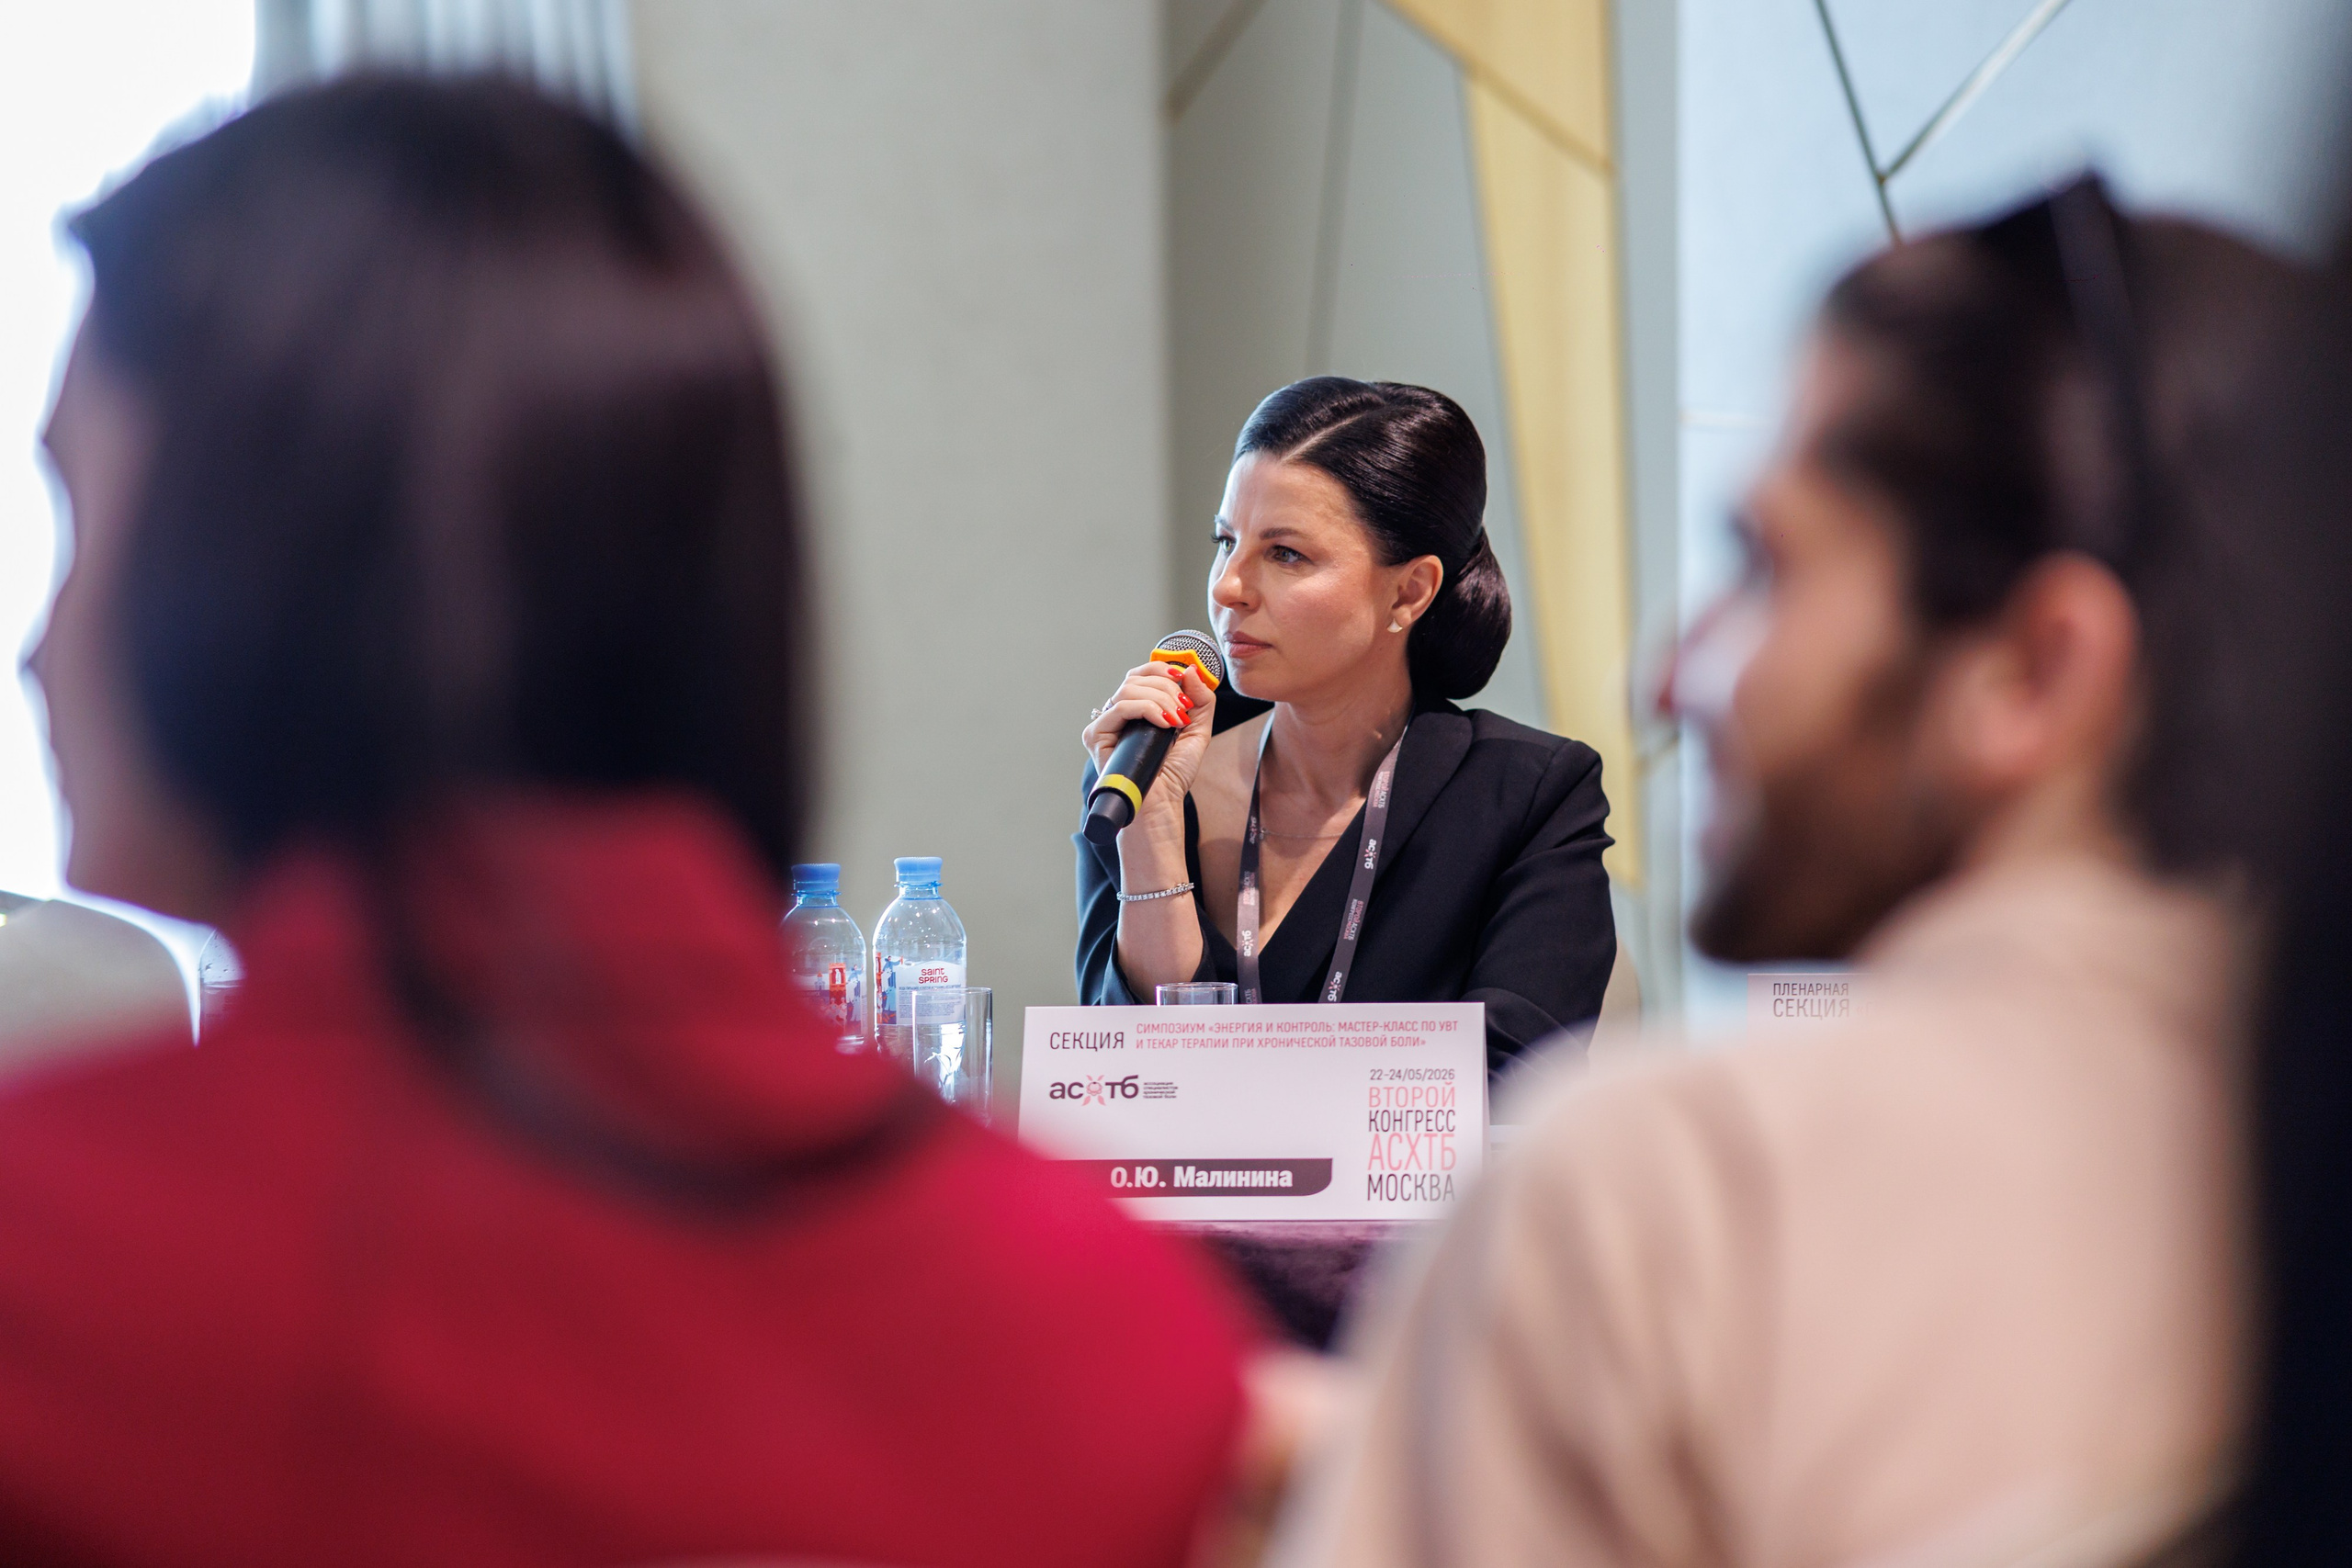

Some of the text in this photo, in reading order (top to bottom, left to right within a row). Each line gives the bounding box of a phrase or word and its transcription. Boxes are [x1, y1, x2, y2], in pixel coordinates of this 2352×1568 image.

[1773, 983, 1849, 996] ПЛЕНАРНАЯ
[1773, 998, 1849, 1020] СЕКЦИЯ
[1136, 1021, 1458, 1034] СИМПОЗИУМ «ЭНЕРГИЯ И КОНТРОЛЬ: МАСТЕР-КЛАСС ПО УВТ
[1049, 1032, 1125, 1052] СЕКЦИЯ
[1136, 1034, 1426, 1049] И ТЕКАР ТЕРАПИИ ПРИ ХРОНИЧЕСКОЙ ТАЗОВОЙ БОЛИ»
[1370, 1068, 1455, 1081] 22-24/05/2026
[1368, 1081, 1455, 1108] ВТОРОЙ
[1368, 1109, 1456, 1133] КОНГРЕСС
[1367, 1133, 1457, 1171] АСХТБ
[1110, 1166, 1294, 1188] О.Ю. Малинина
[1367, 1173, 1455, 1201] МОСКВА
